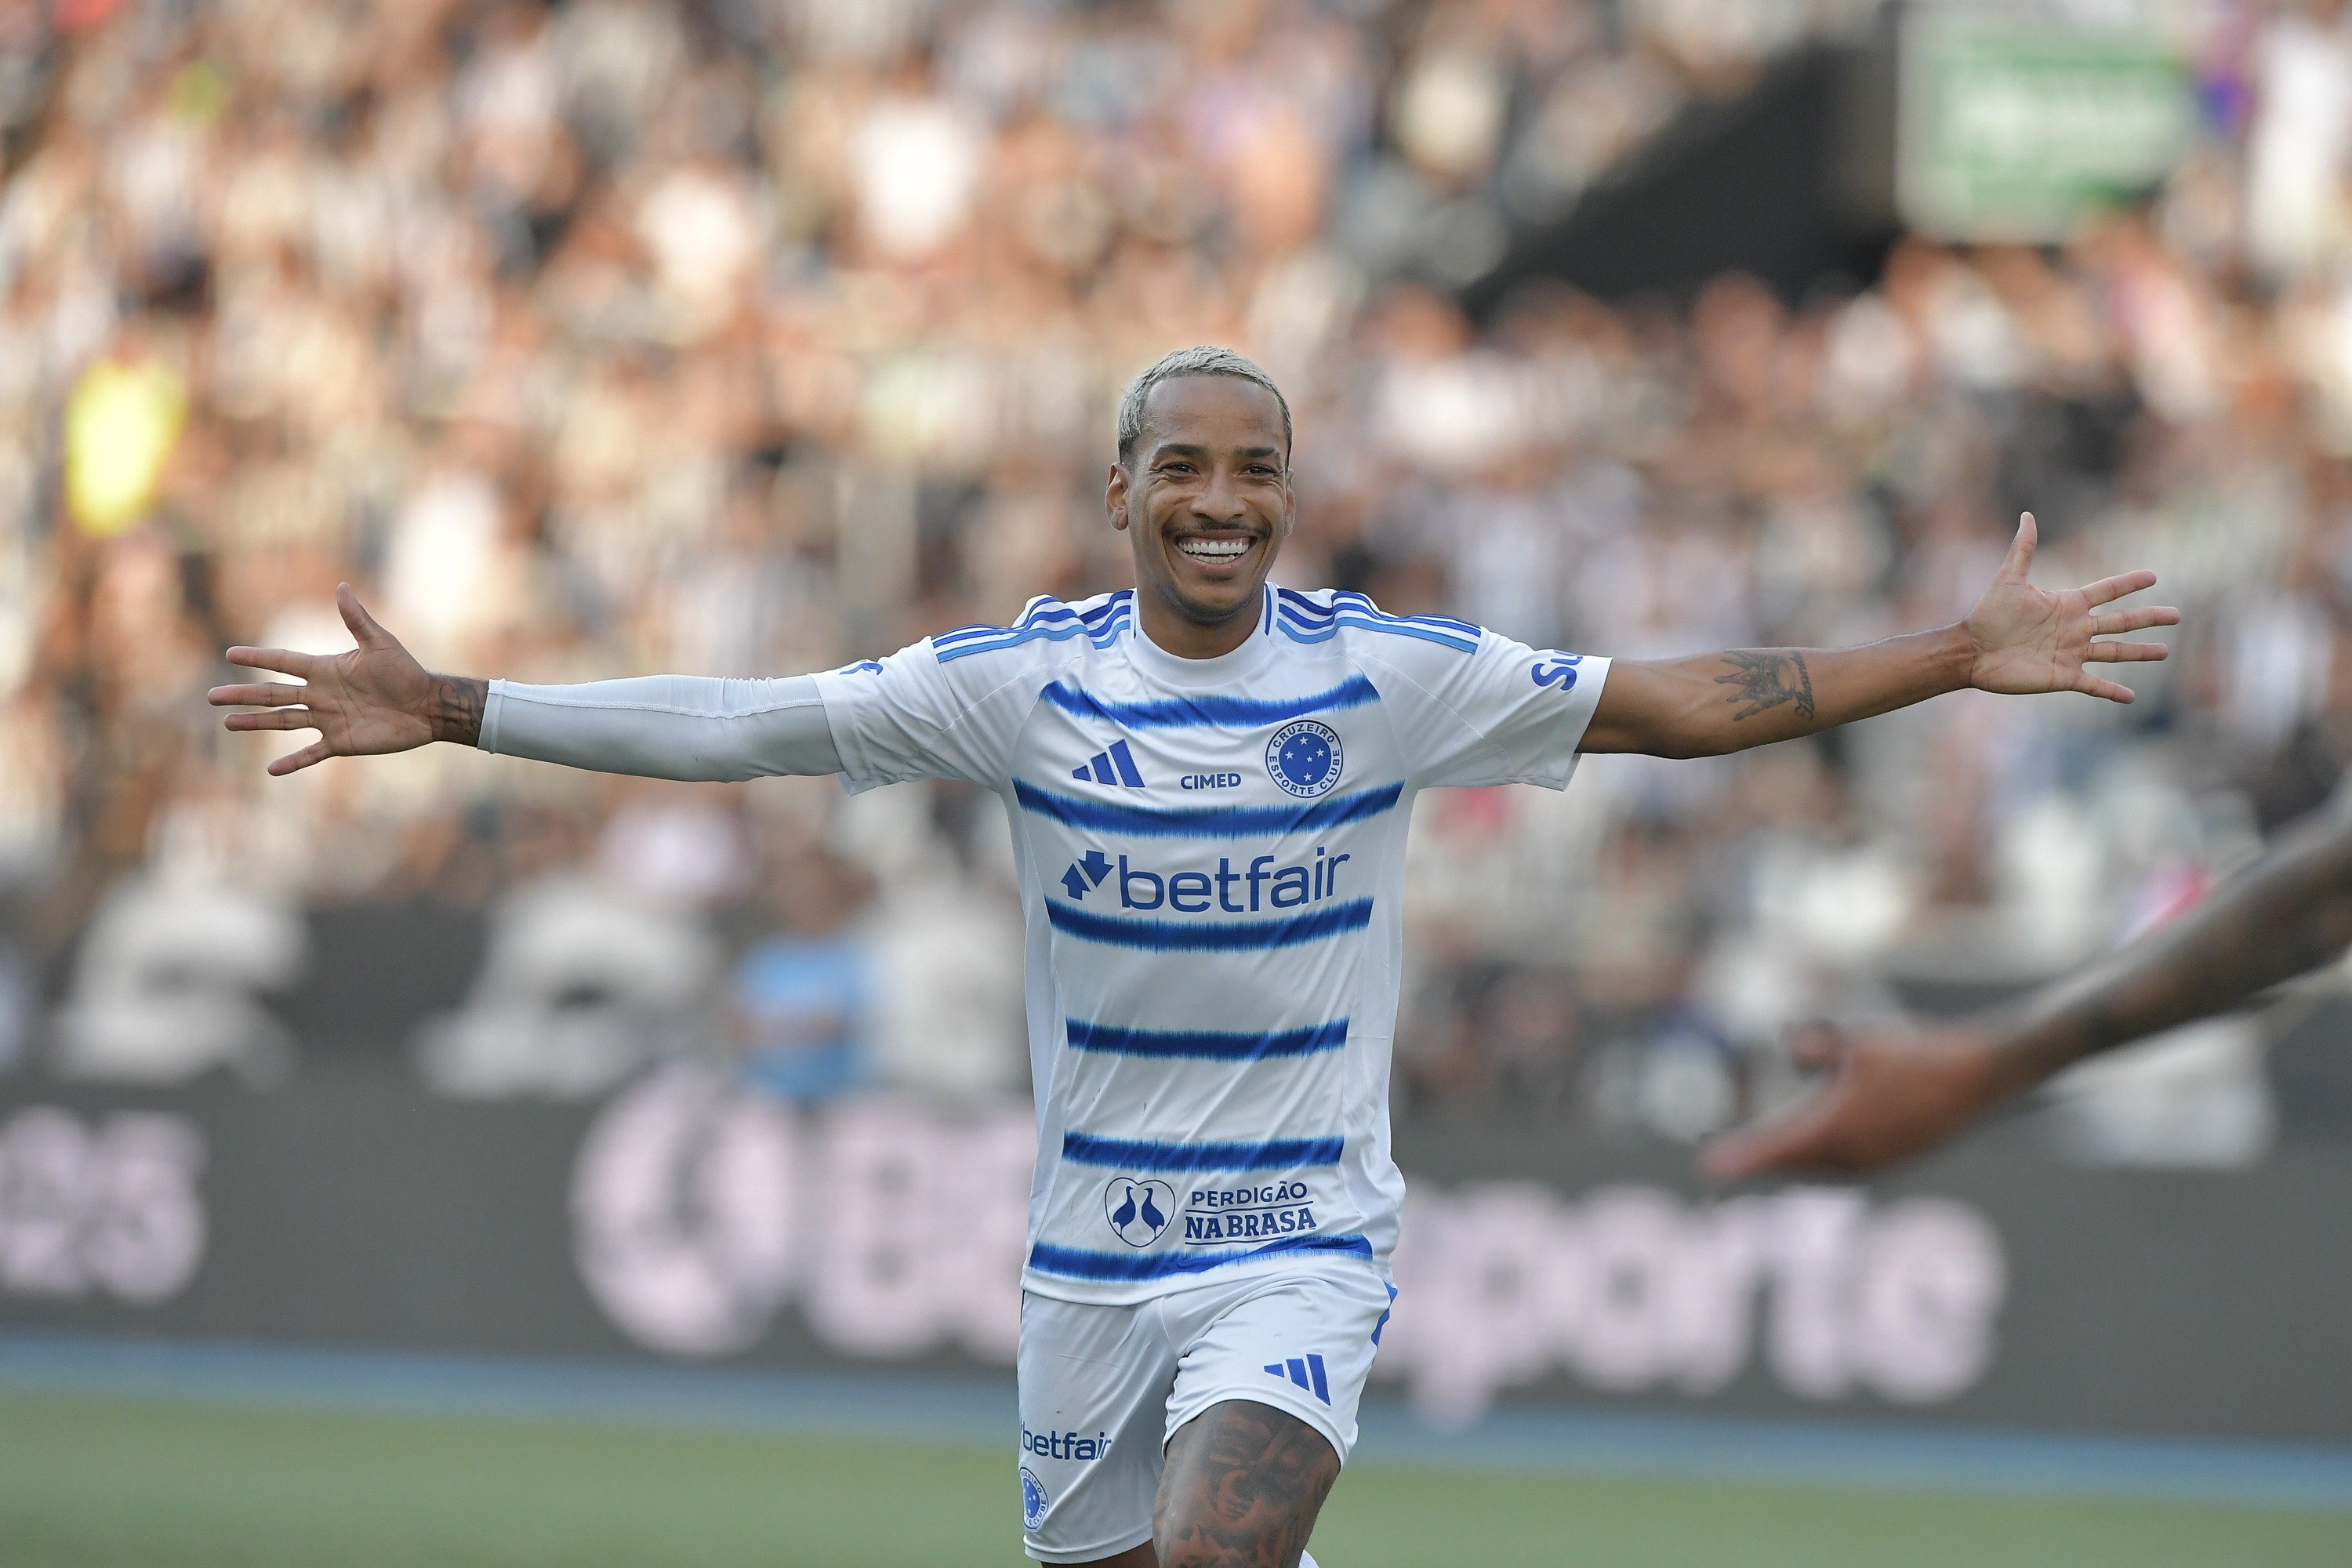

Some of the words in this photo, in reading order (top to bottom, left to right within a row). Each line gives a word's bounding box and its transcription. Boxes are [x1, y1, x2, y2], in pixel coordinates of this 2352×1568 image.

[1272, 724, 1335, 748] CRUZEIRO
[1180, 772, 1241, 789] CIMED
[1269, 755, 1315, 795] ESPORTE
[1319, 749, 1340, 789] CLUBE
[1119, 846, 1351, 913] betfair
[1191, 1181, 1308, 1207] PERDIGÃO
[1185, 1216, 1223, 1239] NA
[1226, 1207, 1317, 1238] BRASA
[1022, 1421, 1112, 1460] betfair
